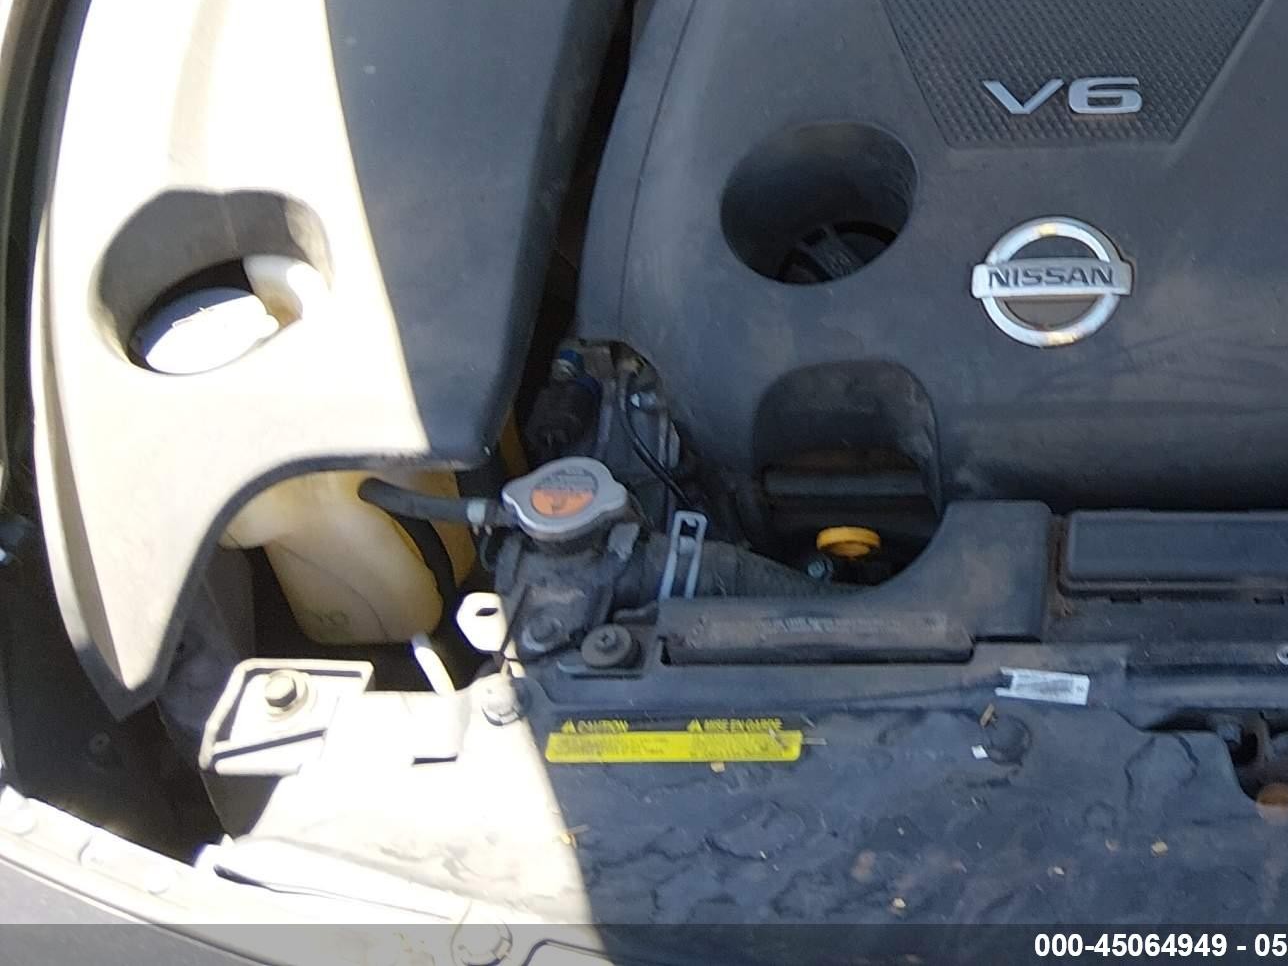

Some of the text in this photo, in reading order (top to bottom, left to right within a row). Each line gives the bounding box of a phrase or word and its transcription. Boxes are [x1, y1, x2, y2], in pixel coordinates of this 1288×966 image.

[982, 77, 1143, 114] V6
[988, 265, 1114, 288] NISSAN
[577, 720, 629, 734] CAUTION
